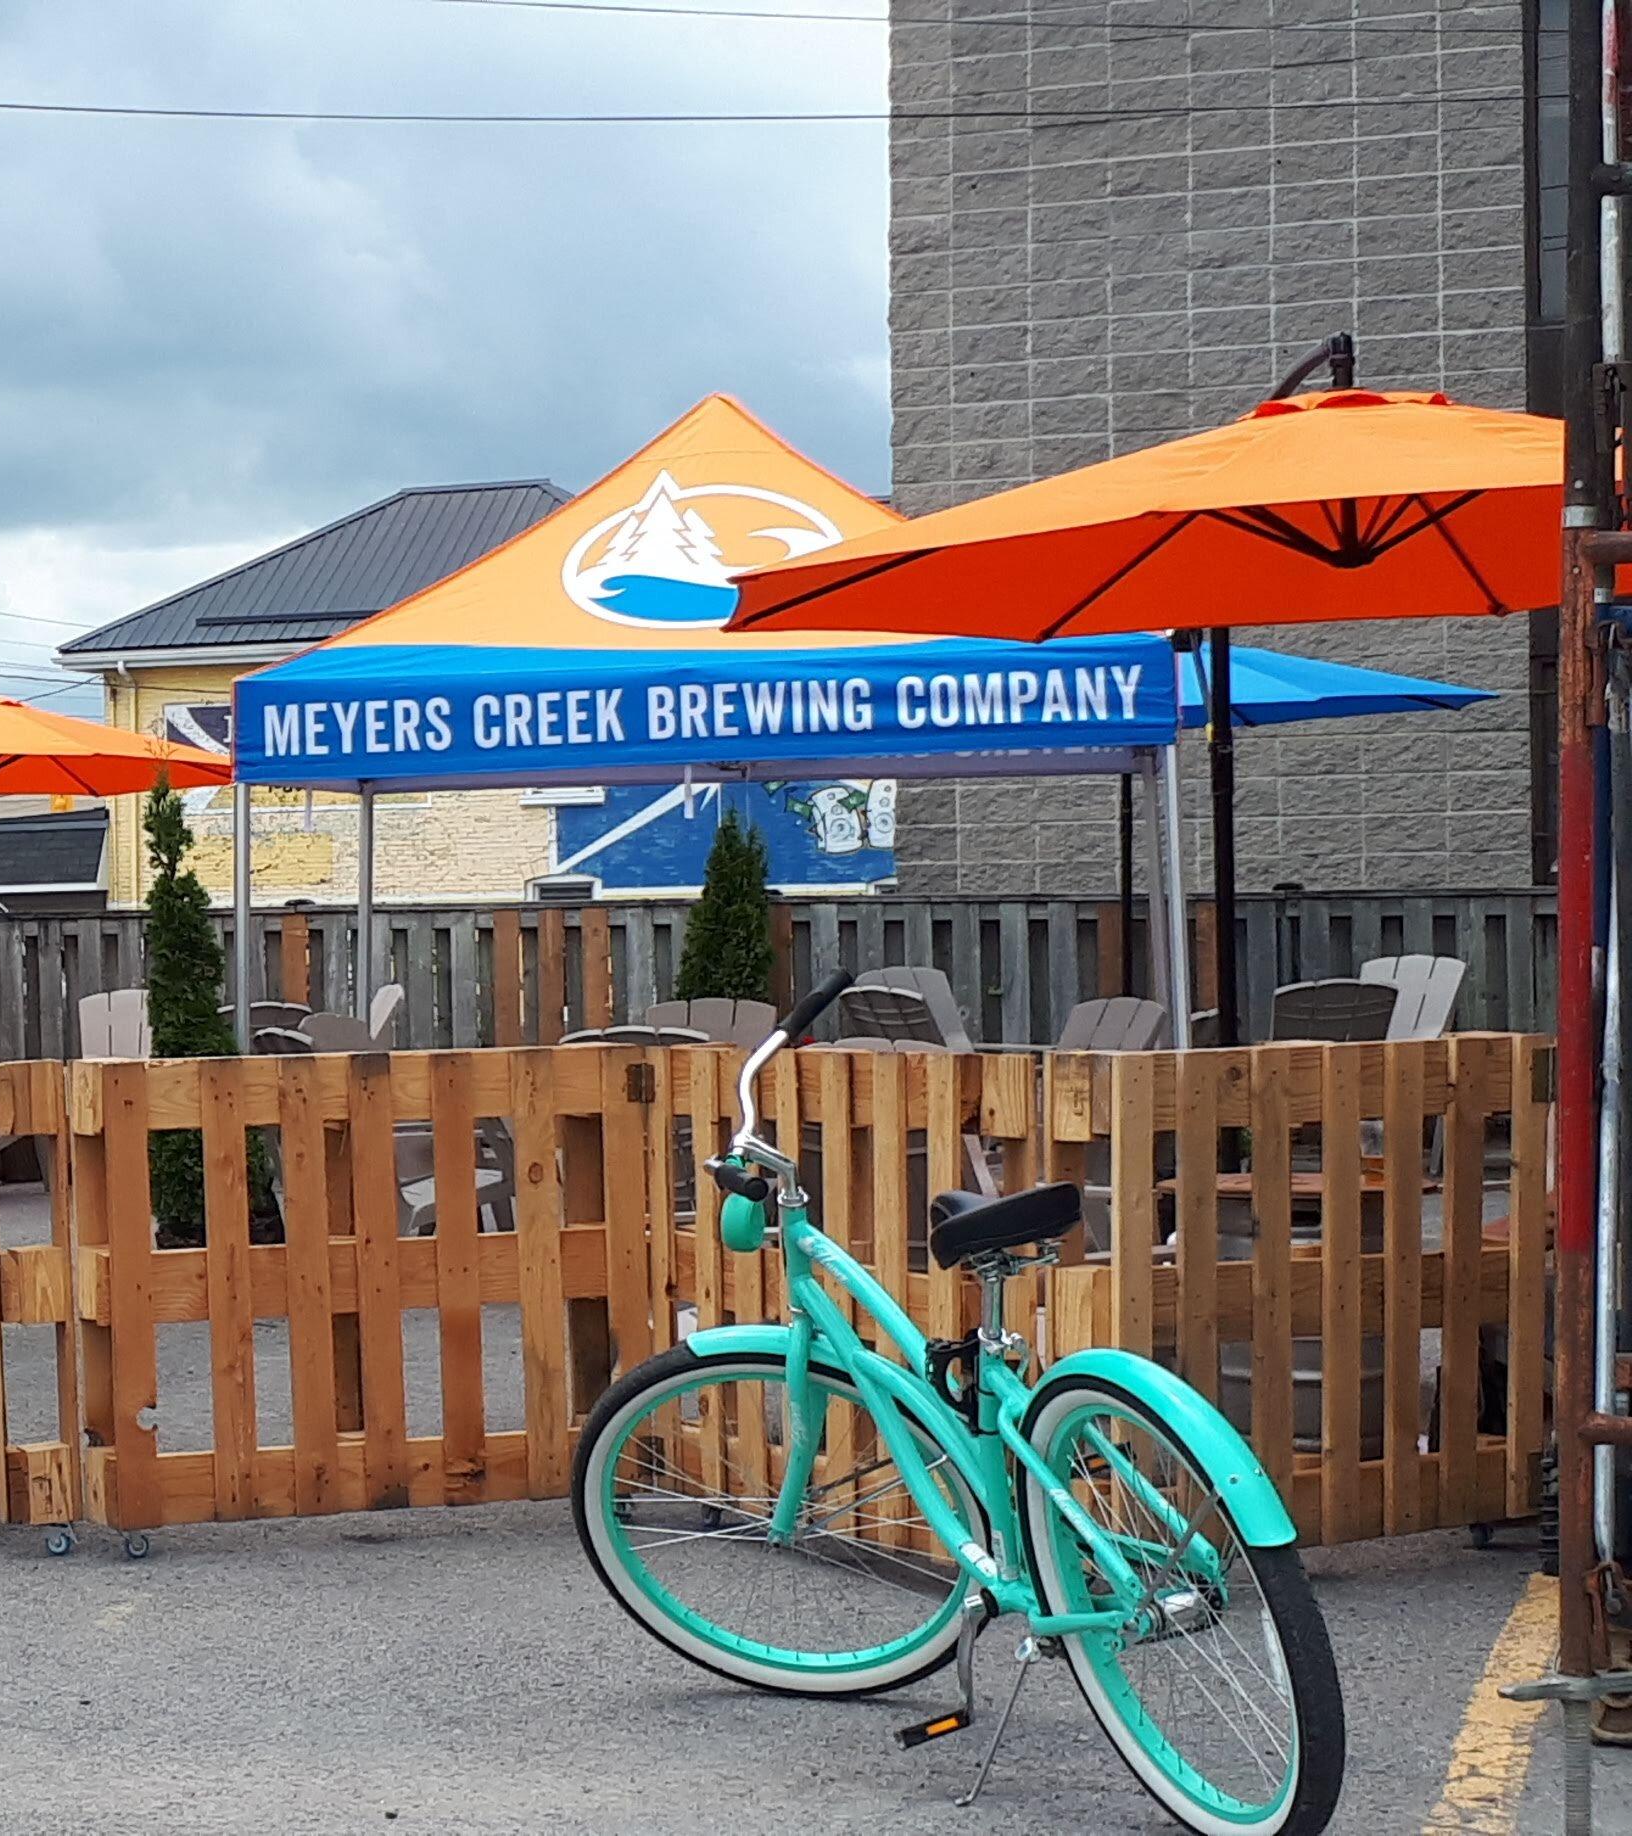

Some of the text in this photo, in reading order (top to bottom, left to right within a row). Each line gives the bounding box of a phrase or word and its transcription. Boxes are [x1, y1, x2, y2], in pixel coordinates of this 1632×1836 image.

[263, 695, 453, 757] MEYERS
[473, 686, 624, 749] CREEK
[647, 676, 873, 741] BREWING
[896, 664, 1145, 731] COMPANY
